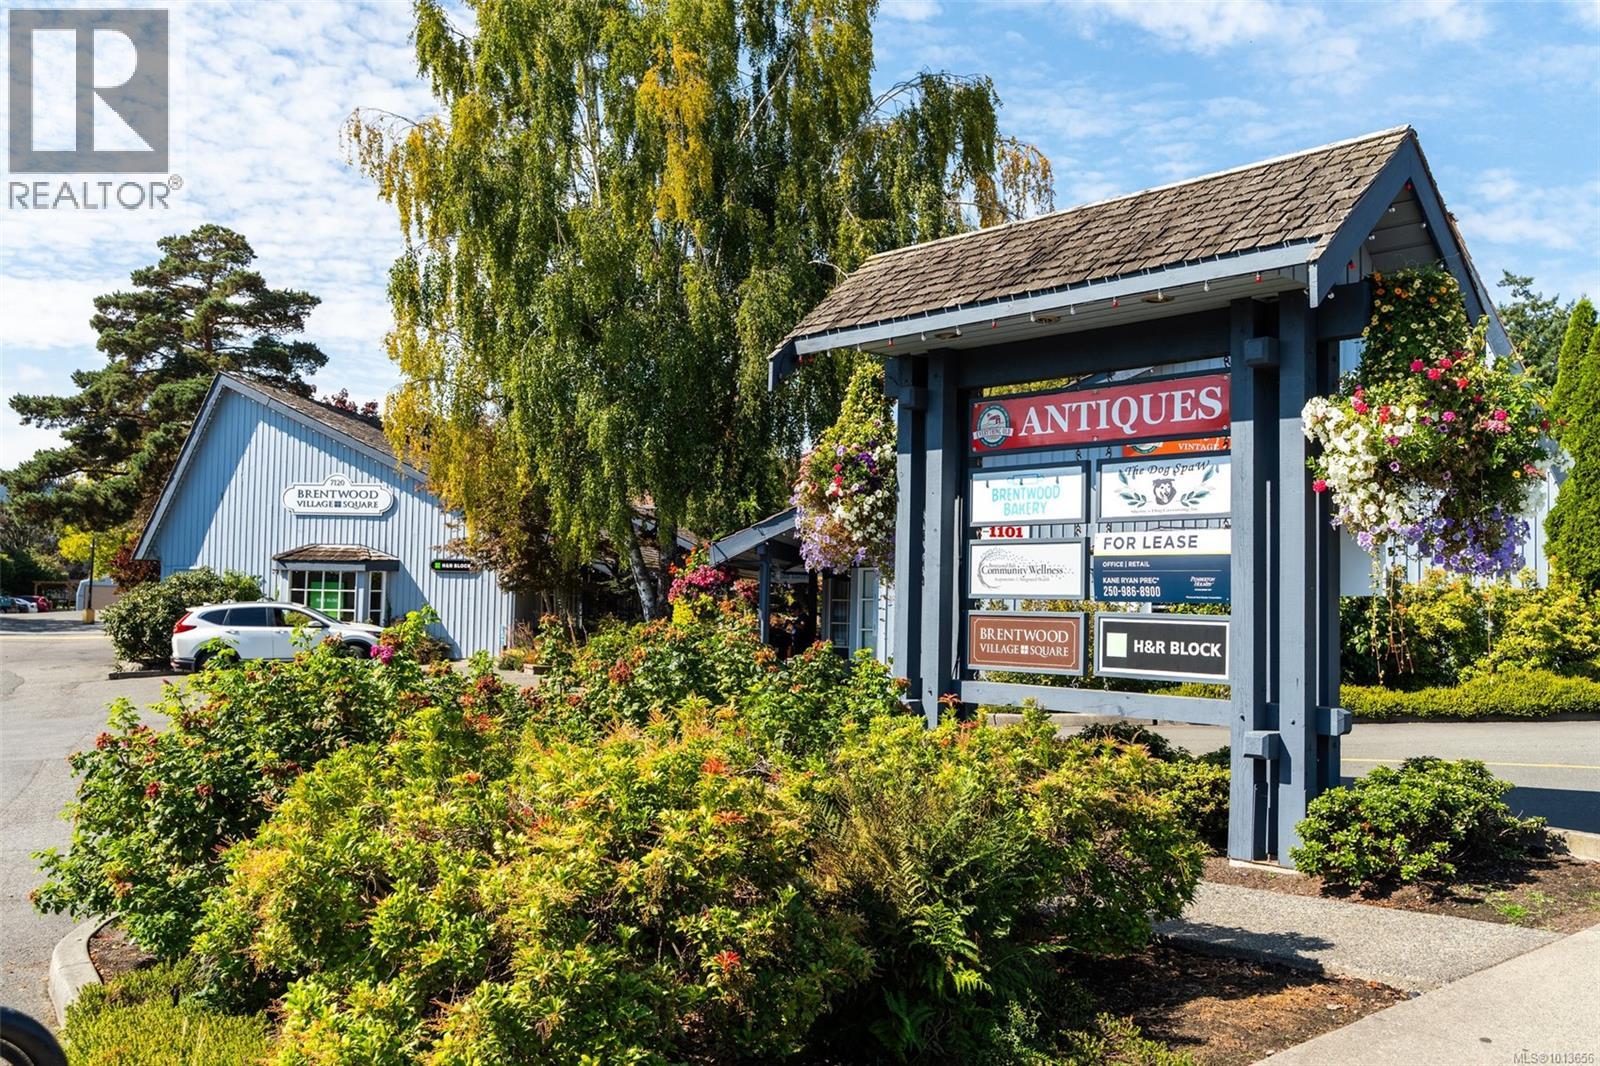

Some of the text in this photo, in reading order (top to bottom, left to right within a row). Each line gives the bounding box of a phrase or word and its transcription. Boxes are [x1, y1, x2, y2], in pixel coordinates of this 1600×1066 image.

[1018, 386, 1222, 437] ANTIQUES
[1178, 442, 1220, 451] VINTAGE
[1125, 465, 1144, 475] The
[1148, 465, 1170, 476] Dog
[297, 489, 379, 499] BRENTWOOD
[992, 485, 1060, 502] BRENTWOOD
[296, 500, 379, 509] VILLAGE SQUARE
[1004, 501, 1047, 516] BAKERY
[1103, 535, 1198, 550] FOR LEASE
[981, 565, 1027, 577] Community
[1028, 564, 1064, 575] Wellness
[1103, 585, 1161, 597] 250-986-8900
[979, 627, 1069, 643] BRENTWOOD
[979, 643, 1069, 658] VILLAGE SQUARE
[1133, 639, 1222, 657] H&R BLOCK
